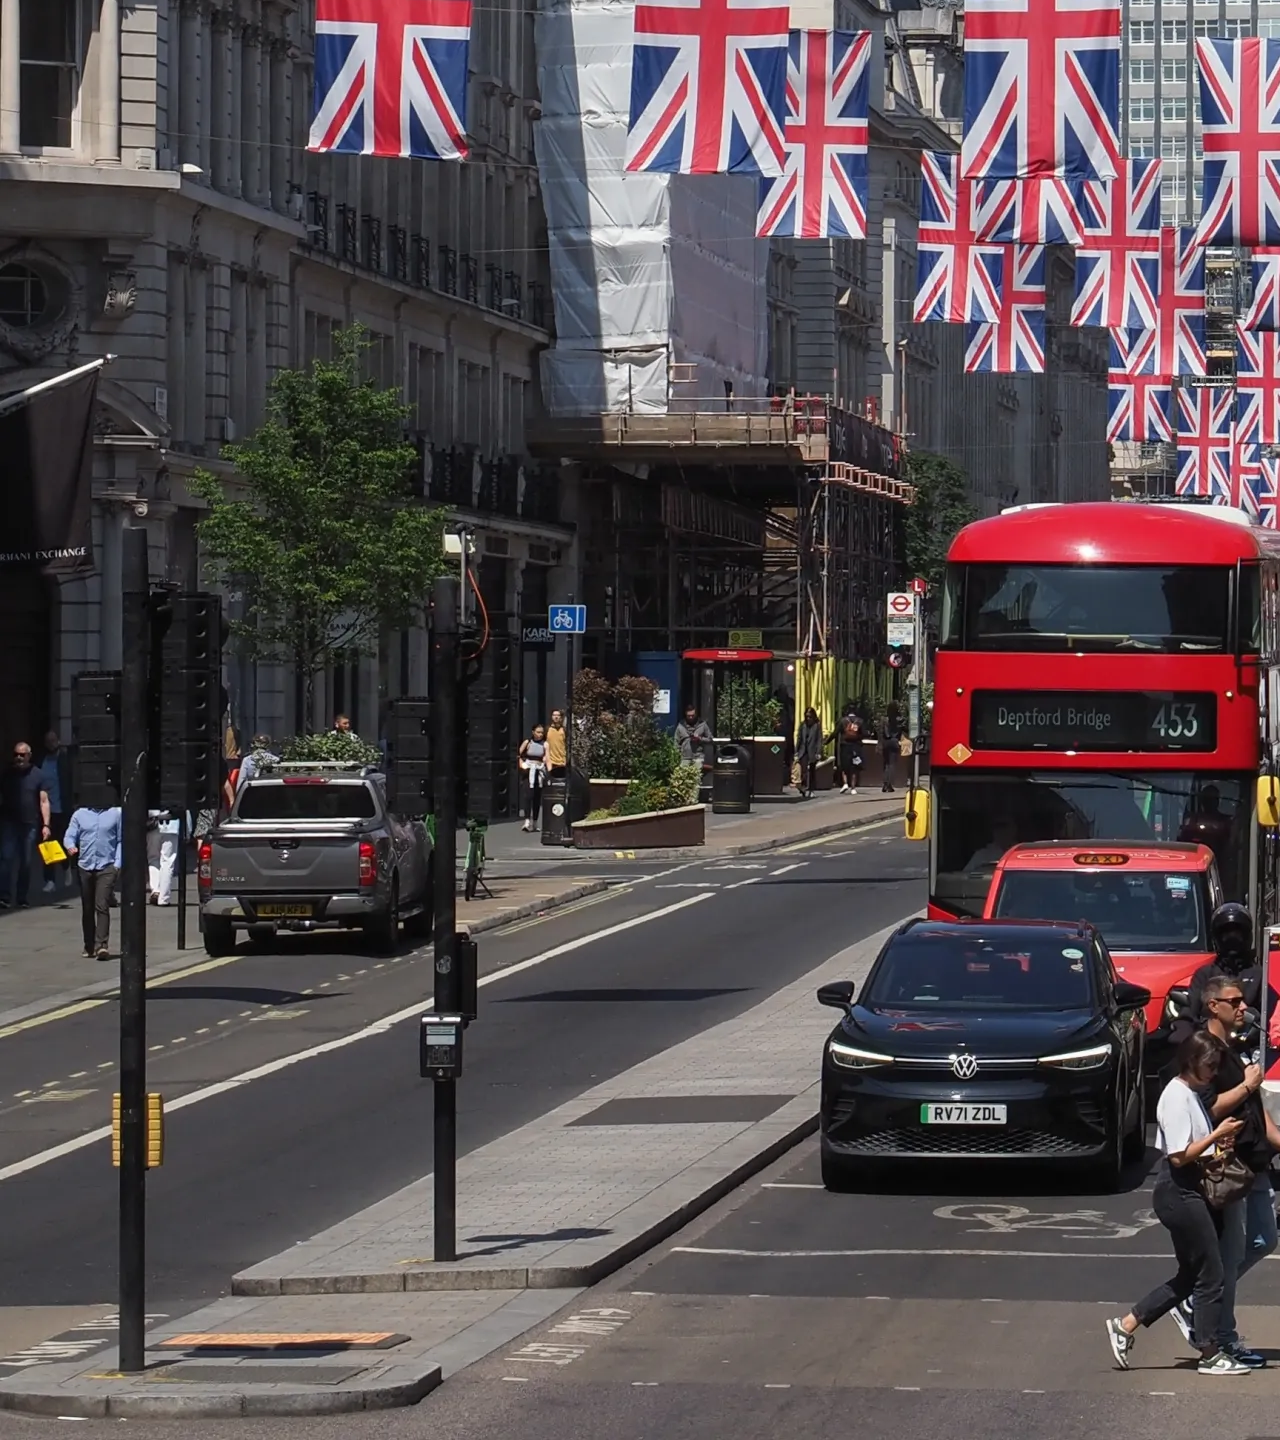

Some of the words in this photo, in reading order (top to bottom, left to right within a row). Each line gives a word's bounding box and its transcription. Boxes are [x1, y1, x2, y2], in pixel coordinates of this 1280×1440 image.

[35, 546, 87, 559] EXCHANGE
[914, 581, 922, 592] L
[998, 707, 1061, 731] Deptford
[1067, 708, 1111, 730] Bridge
[1152, 703, 1198, 737] 453
[1082, 856, 1120, 864] TAXI
[934, 1107, 968, 1121] RV71
[971, 1107, 1001, 1121] ZDL
